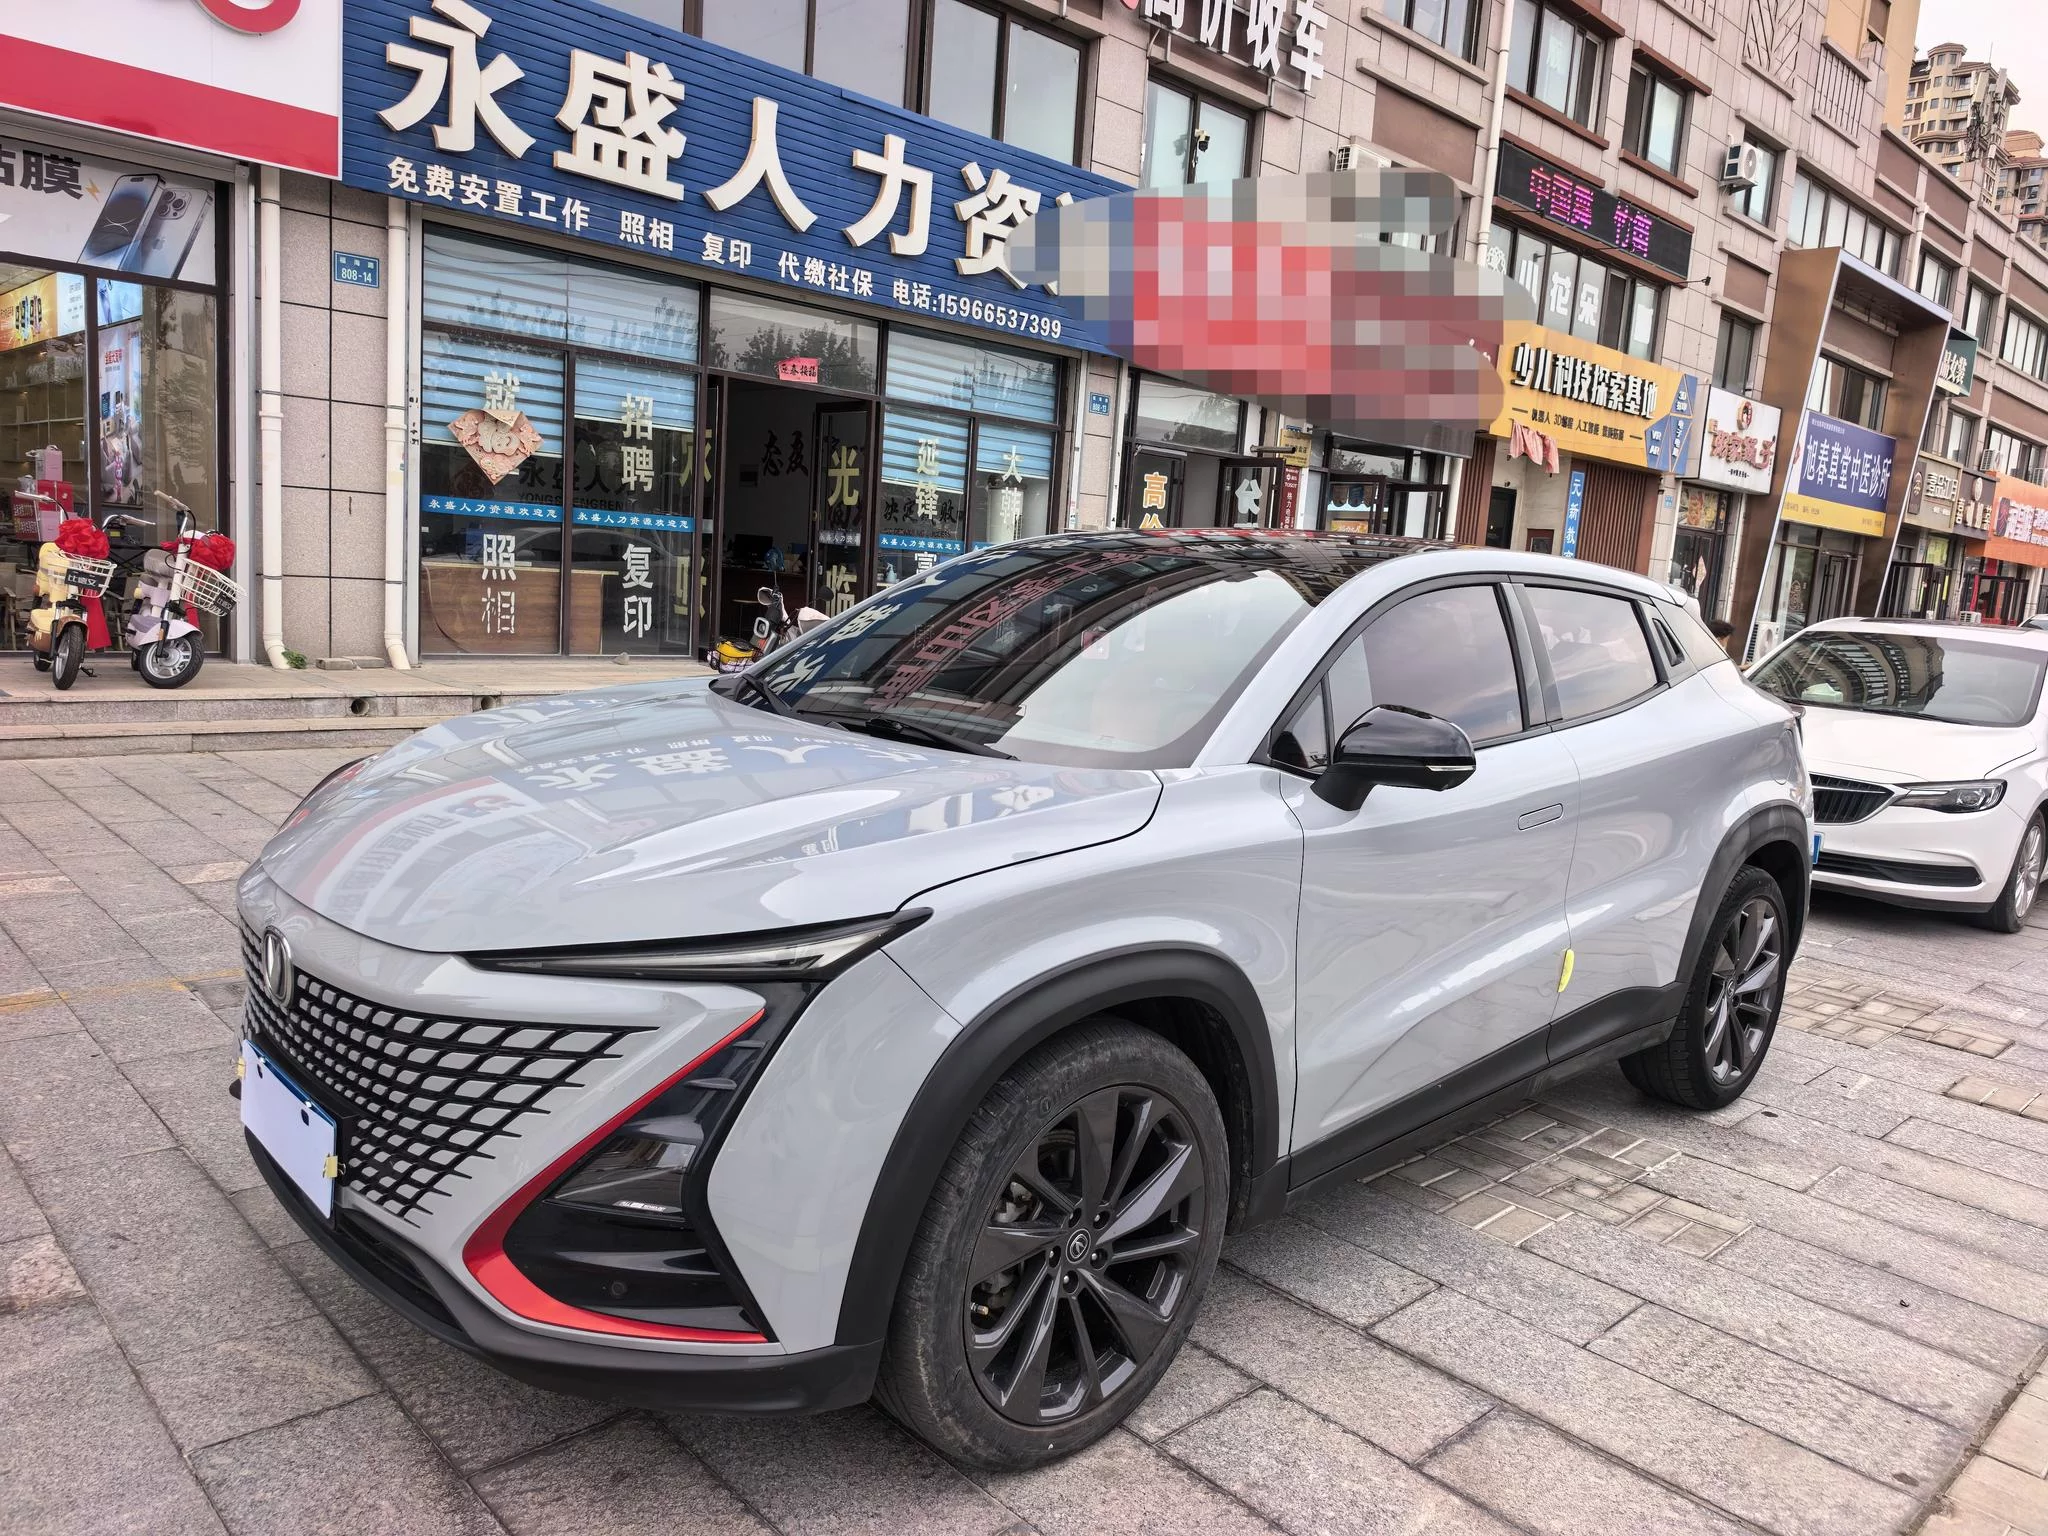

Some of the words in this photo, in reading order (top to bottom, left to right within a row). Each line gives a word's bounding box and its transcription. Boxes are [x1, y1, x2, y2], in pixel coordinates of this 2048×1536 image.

[377, 0, 1058, 296] 永盛人力资
[341, 267, 372, 283] 808-14
[387, 156, 591, 232] 免费安置工作
[619, 210, 674, 252] 照相
[702, 232, 752, 269] 复印
[778, 250, 874, 297] 代缴社保
[893, 278, 1062, 339] 电话:15966537399
[1512, 342, 1659, 419] 少儿科技探索基地
[620, 393, 655, 492] 招聘
[1651, 430, 1662, 441] VR
[1803, 434, 1892, 500] 旭春草堂中医诊所
[428, 498, 558, 519] 永盛人力资源欢迎您
[577, 511, 690, 529] 永盛人力资源欢迎您
[880, 537, 961, 551] 永盛人力资源欢迎您
[482, 533, 517, 634] 照相
[622, 543, 653, 639] 复印
